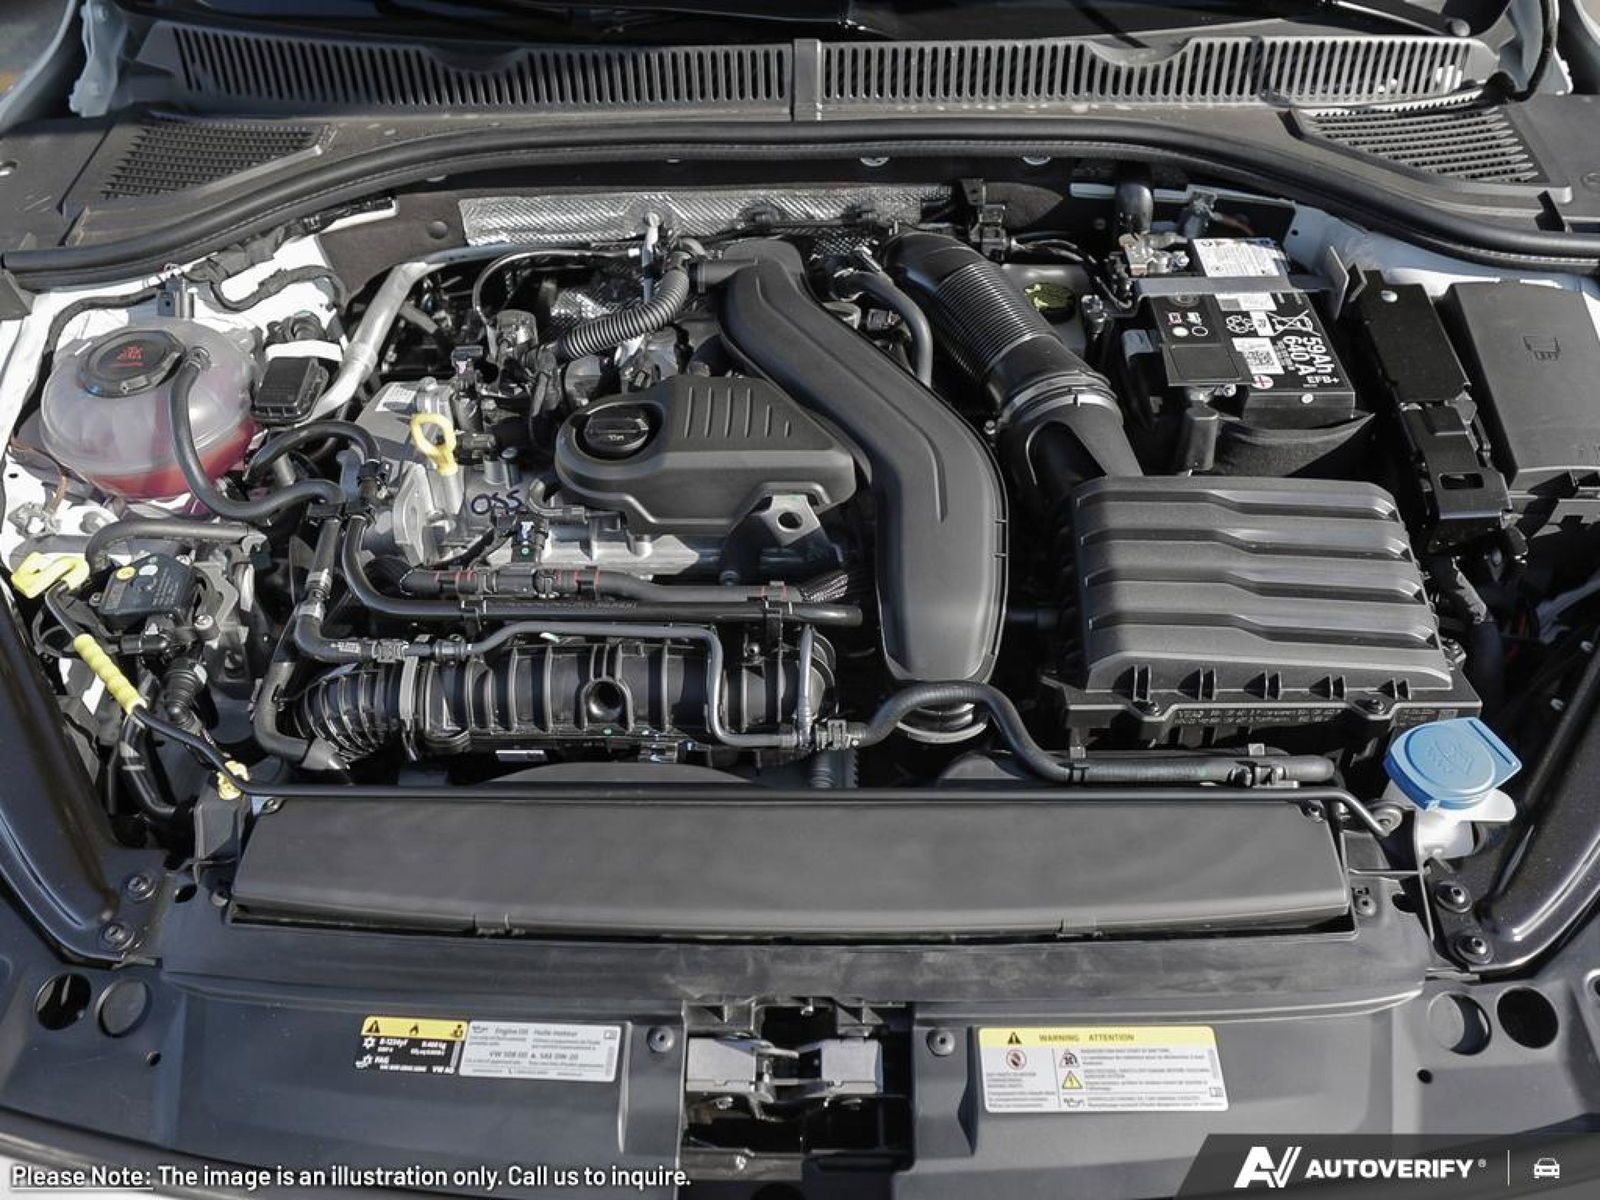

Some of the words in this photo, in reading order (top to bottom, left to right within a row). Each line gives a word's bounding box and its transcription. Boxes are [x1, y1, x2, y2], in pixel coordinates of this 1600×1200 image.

[1283, 335, 1308, 362] 640
[1297, 360, 1318, 376] A
[1303, 337, 1335, 374] 59Ah
[1038, 1034, 1080, 1042] WARNING
[1088, 1033, 1135, 1042] ATTENTION
